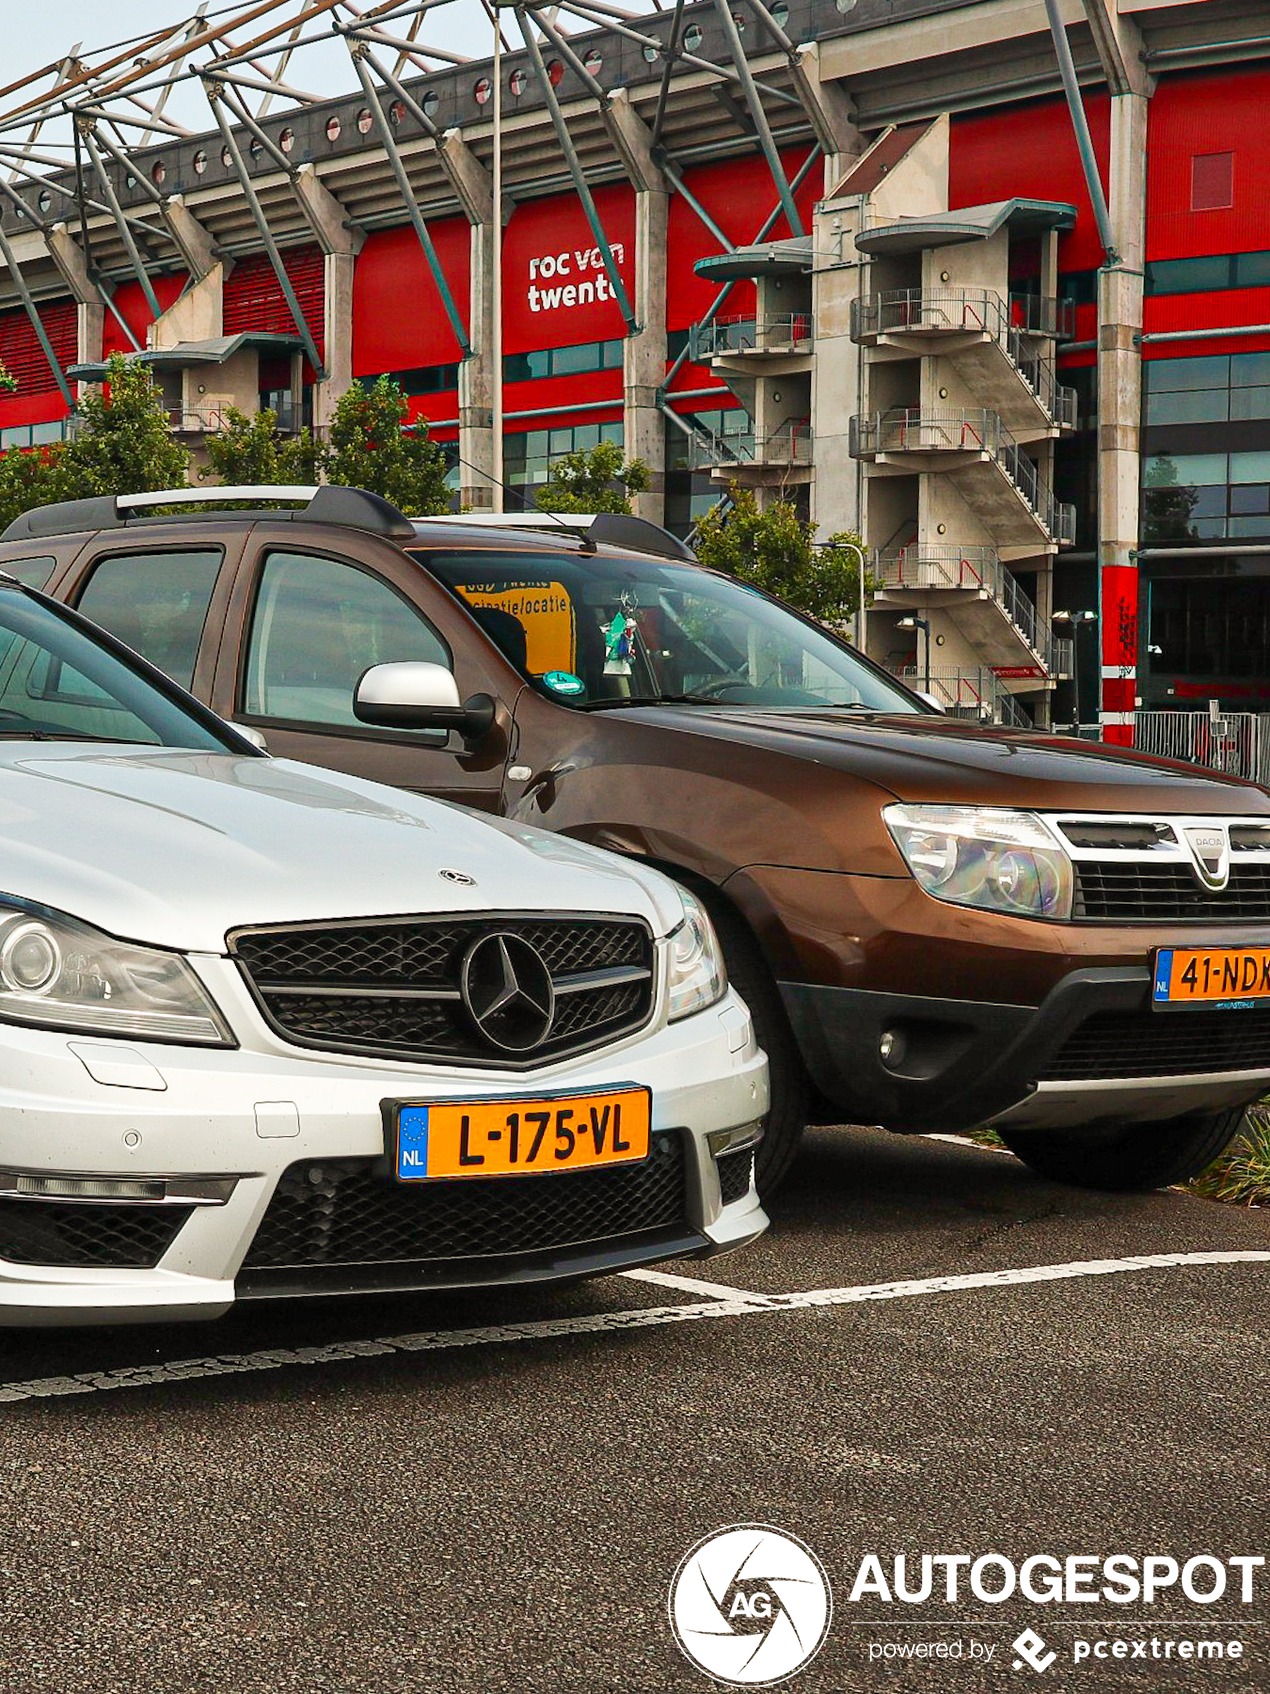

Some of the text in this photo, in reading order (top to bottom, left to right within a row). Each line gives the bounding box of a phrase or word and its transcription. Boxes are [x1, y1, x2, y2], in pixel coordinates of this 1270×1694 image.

[529, 242, 625, 281] roc van
[1156, 980, 1168, 993] NL
[459, 1103, 631, 1167] L-175-VL
[402, 1150, 424, 1167] NL
